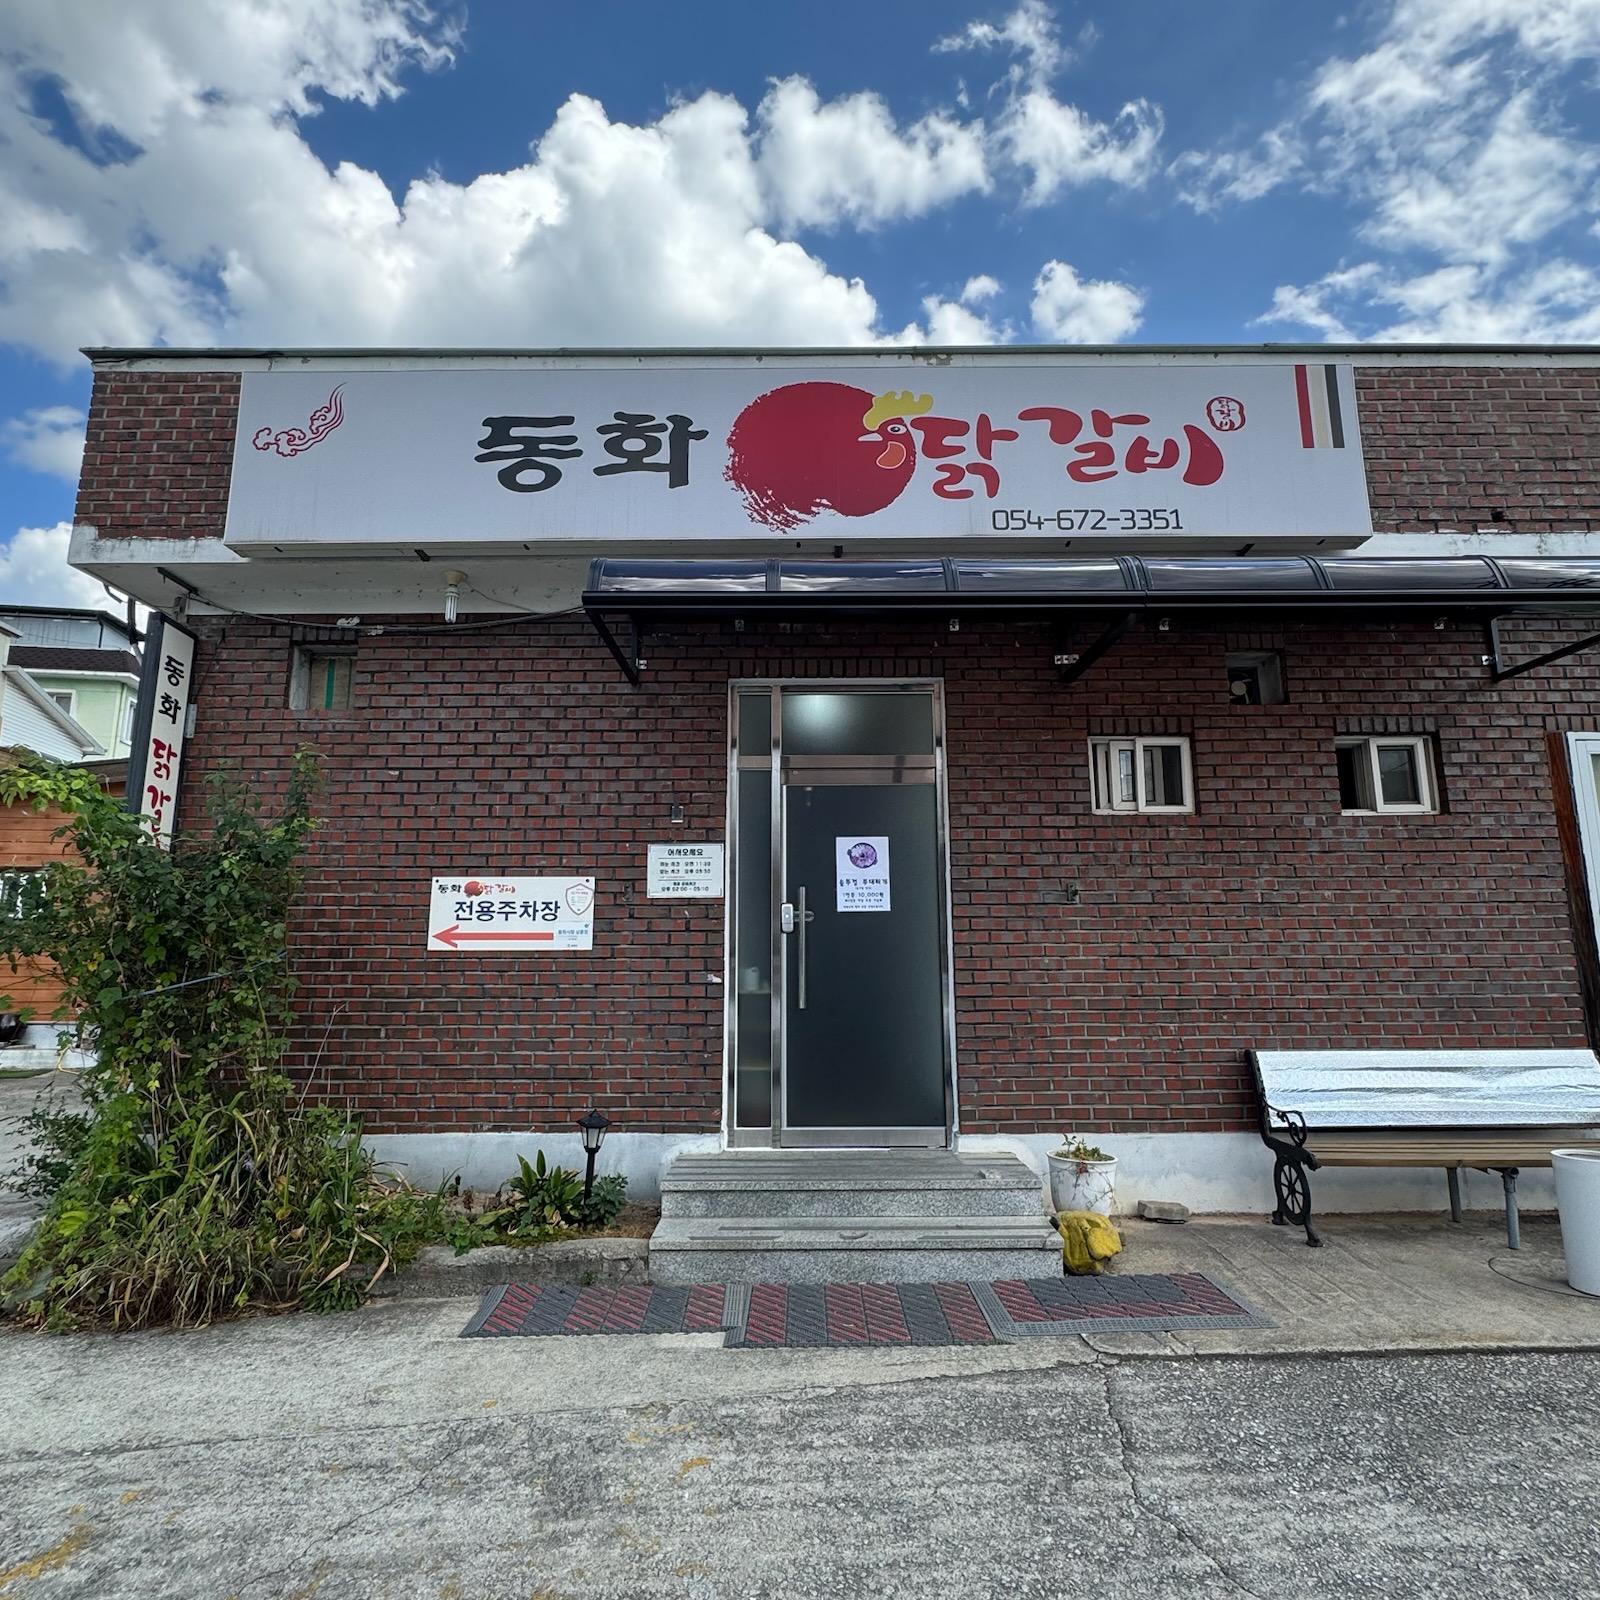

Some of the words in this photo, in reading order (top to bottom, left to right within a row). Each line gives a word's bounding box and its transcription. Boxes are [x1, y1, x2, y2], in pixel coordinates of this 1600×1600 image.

[474, 411, 709, 493] 동화
[911, 407, 1225, 500] 닭갈비
[992, 508, 1183, 531] 054-672-3351
[158, 655, 185, 725] 동화
[667, 848, 704, 856] 어서오세요
[438, 884, 462, 893] 동화
[454, 900, 561, 921] 전용주차장
